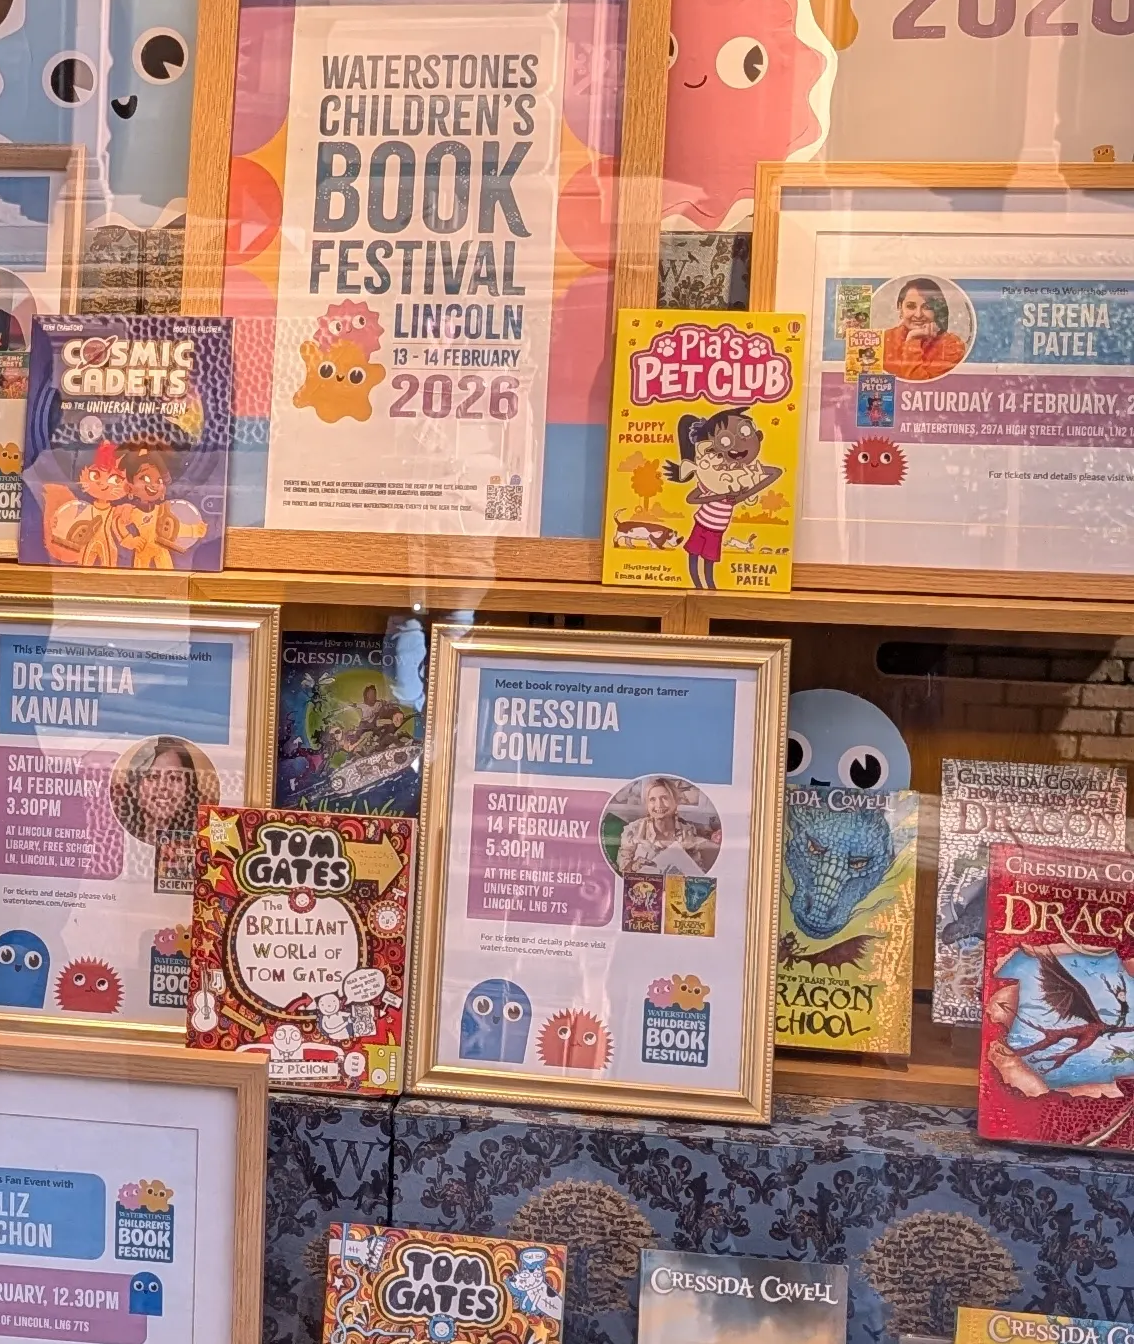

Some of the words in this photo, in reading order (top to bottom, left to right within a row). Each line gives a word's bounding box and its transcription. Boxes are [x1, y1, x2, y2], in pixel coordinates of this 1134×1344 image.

[322, 54, 538, 89] WATERSTONES
[319, 93, 536, 136] CHILDREN'S
[313, 140, 532, 237] BOOK
[310, 240, 525, 296] FESTIVAL
[394, 303, 522, 339] LINCOLN
[1023, 302, 1110, 328] SERENA
[681, 330, 742, 360] Pia's
[1033, 331, 1097, 356] PATEL
[393, 348, 407, 364] 13
[424, 348, 438, 365] 14
[444, 349, 520, 366] FEBRUARY
[63, 369, 186, 395] CADETS
[637, 360, 704, 397] PET
[708, 364, 789, 397] CLUB
[389, 373, 519, 420] 2026
[901, 390, 992, 412] SATURDAY
[998, 390, 1016, 412] 14
[1023, 392, 1120, 416] FEBRUARY,
[628, 421, 664, 431] PUPPY
[618, 433, 674, 444] PROBLEM
[730, 563, 776, 574] SERENA
[736, 575, 770, 586] PATEL
[13, 662, 44, 691] DR
[50, 664, 133, 695] SHEILA
[495, 679, 522, 689] Meet
[526, 680, 552, 690] book
[555, 683, 591, 694] royalty
[594, 684, 613, 693] and
[616, 684, 652, 696] dragon
[656, 687, 688, 696] tamer
[12, 696, 98, 726] KANANI
[494, 697, 619, 731] CRESSIDA
[492, 732, 592, 764] COWELL
[8, 755, 84, 774] SATURDAY
[8, 776, 22, 793] 14
[28, 777, 103, 797] FEBRUARY
[7, 797, 60, 816] 3.30PM
[488, 793, 568, 816] SATURDAY
[487, 815, 502, 832] 14
[508, 816, 590, 838] FEBRUARY
[264, 830, 335, 858] TOM
[486, 838, 544, 861] 5.30PM
[248, 857, 347, 888] GATES
[484, 867, 496, 878] AT
[498, 868, 516, 879] THE
[520, 870, 554, 884] ENGINE
[1006, 857, 1098, 879] CRESSIDA
[484, 882, 539, 899] UNIVERSITY
[542, 886, 554, 897] OF
[262, 899, 282, 910] The
[246, 915, 348, 935] BRILLIANT
[324, 948, 342, 959] OF
[646, 1028, 705, 1049] BOOK
[646, 1048, 704, 1063] FESTIVAL
[5, 1175, 20, 1184] Fan
[24, 1176, 50, 1186] Event
[52, 1179, 73, 1188] with
[403, 1250, 485, 1284] TOM
[651, 1267, 753, 1298] CRESSIDA
[760, 1276, 838, 1304] COWELL
[53, 1287, 118, 1309] 12.30PM
[386, 1284, 498, 1320] GATES
